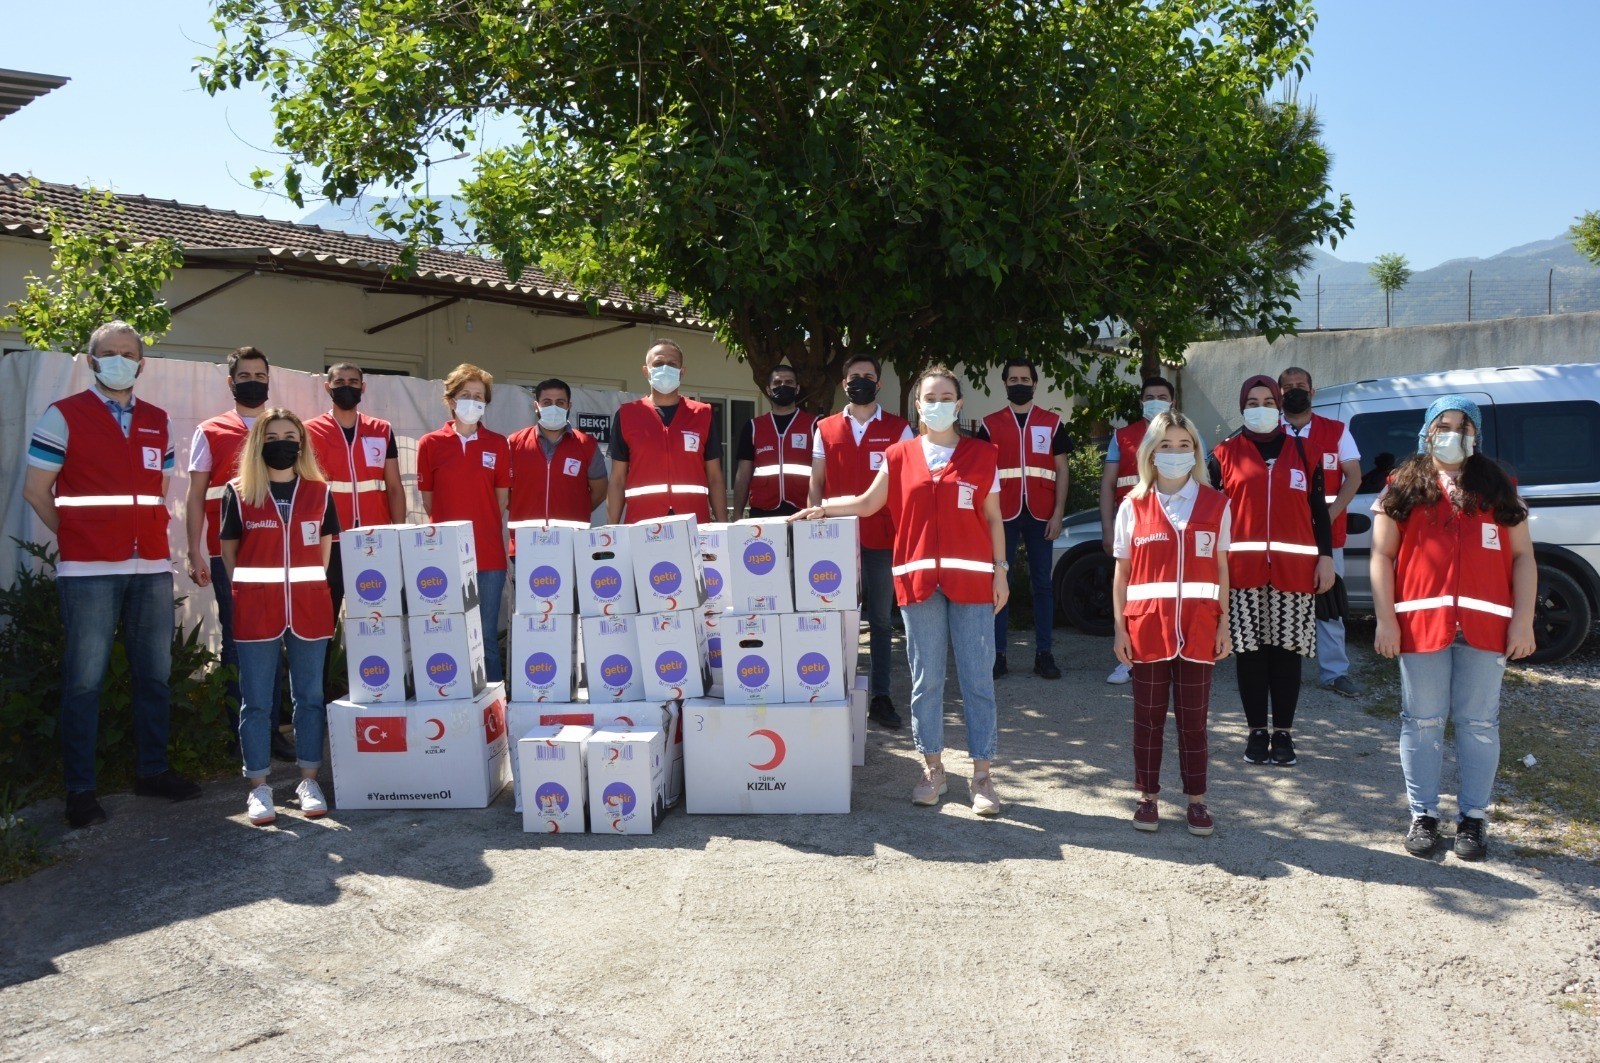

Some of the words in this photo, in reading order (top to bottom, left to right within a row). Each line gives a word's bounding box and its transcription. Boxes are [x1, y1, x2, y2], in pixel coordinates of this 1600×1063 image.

[580, 417, 609, 430] BEKÇİ
[245, 520, 279, 530] Gönüllü
[1134, 532, 1170, 547] Gönüllü
[421, 577, 443, 588] getir
[533, 576, 557, 587] getir
[595, 576, 617, 589] getir
[653, 571, 677, 584] getir
[813, 570, 837, 583] getir
[360, 580, 382, 591] getir
[363, 665, 386, 677] getir
[430, 663, 453, 675] getir
[529, 663, 553, 674] getir
[604, 664, 629, 677] getir
[659, 660, 683, 673] getir
[741, 665, 766, 678] getir
[801, 663, 826, 675] getir
[694, 714, 704, 731] 3
[747, 782, 787, 791] KIZILAY
[367, 790, 452, 801] #YardımsevenOl
